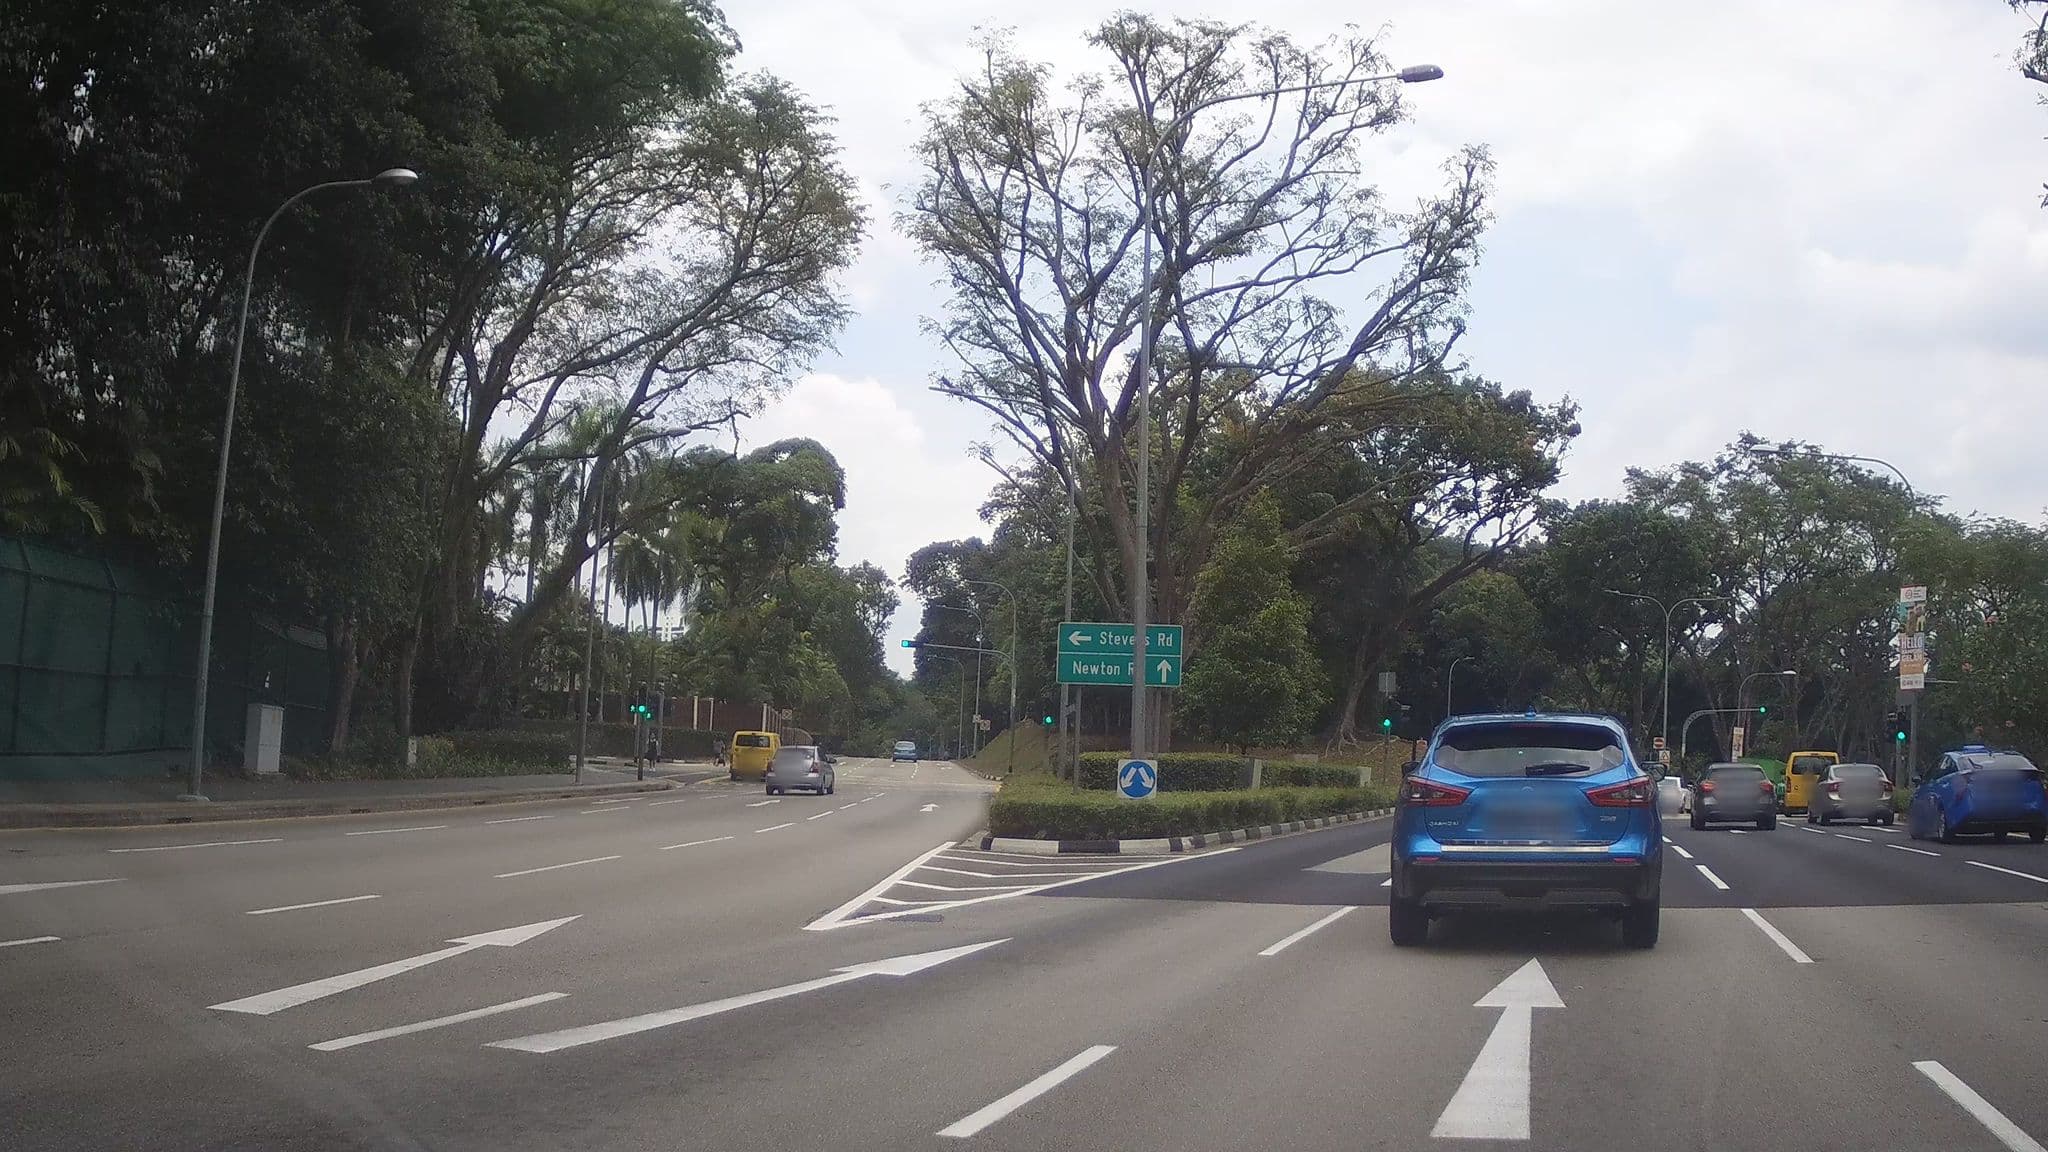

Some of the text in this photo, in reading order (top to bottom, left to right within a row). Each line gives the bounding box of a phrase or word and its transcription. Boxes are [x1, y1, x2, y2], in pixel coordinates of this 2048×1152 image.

[1100, 631, 1172, 647] Steves Rd
[1073, 661, 1120, 676] Newton
